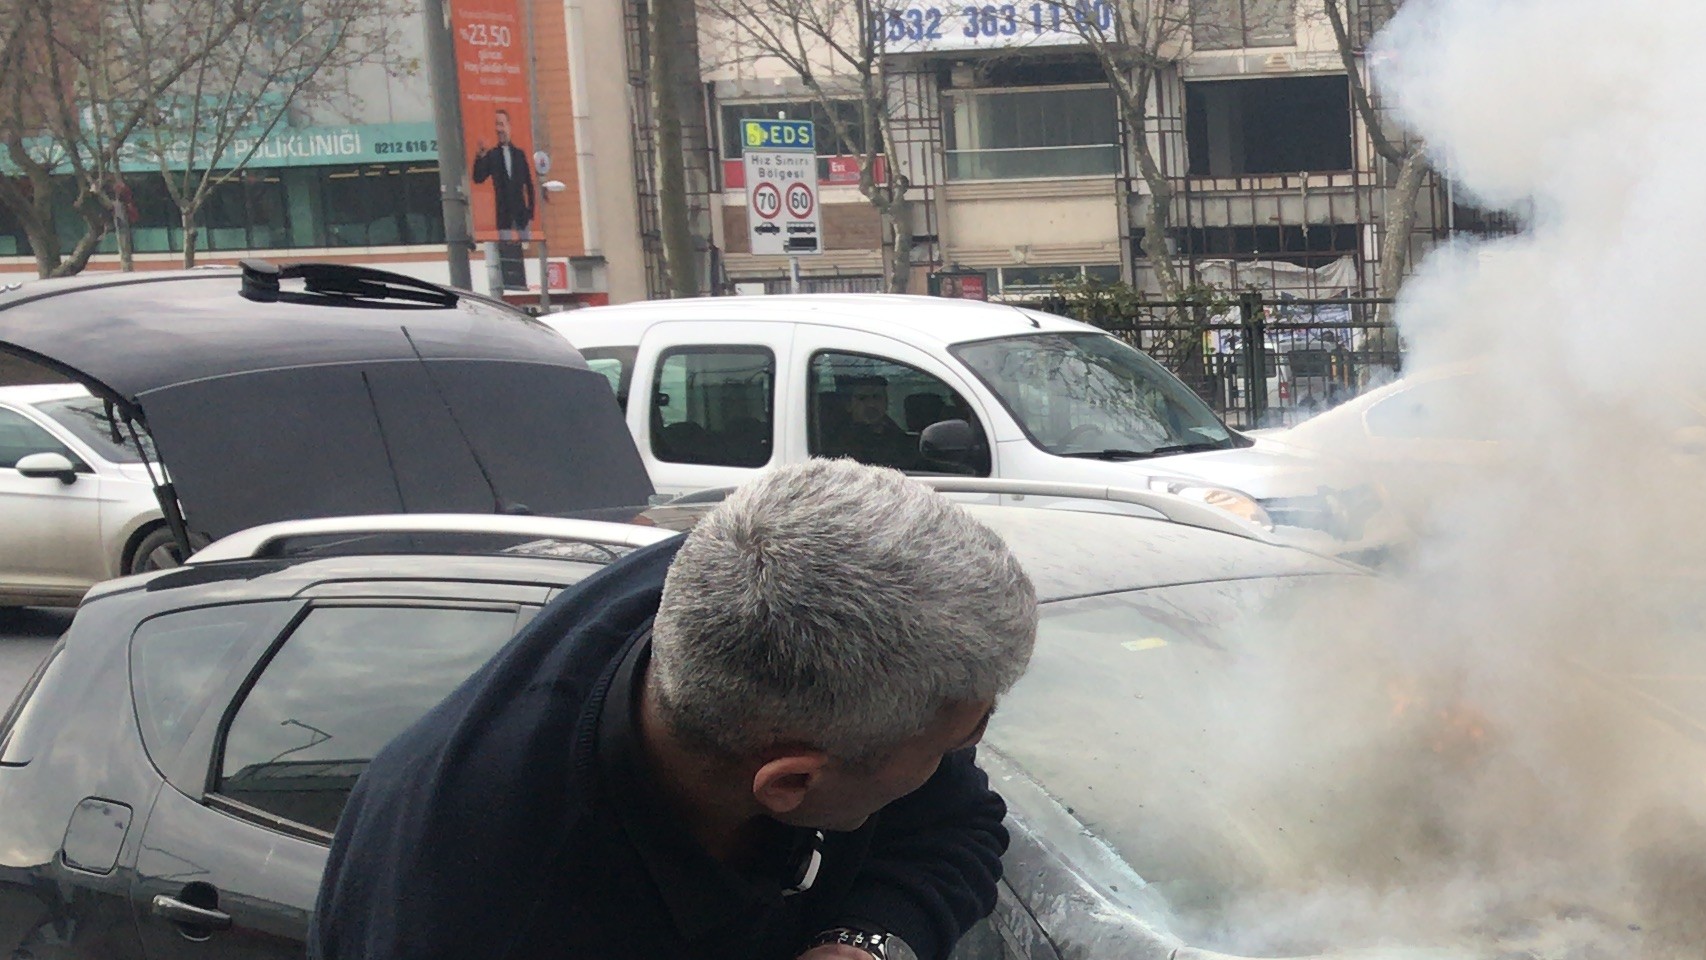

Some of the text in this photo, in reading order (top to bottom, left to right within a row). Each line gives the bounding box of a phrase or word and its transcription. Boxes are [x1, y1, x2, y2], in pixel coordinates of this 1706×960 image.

[962, 4, 1016, 38] 363
[1029, 3, 1060, 34] 11
[770, 125, 810, 145] EDS
[374, 141, 403, 154] 0212
[751, 155, 771, 166] Hız
[758, 167, 804, 181] Bölgesi
[758, 193, 776, 210] 70
[791, 192, 808, 209] 60
